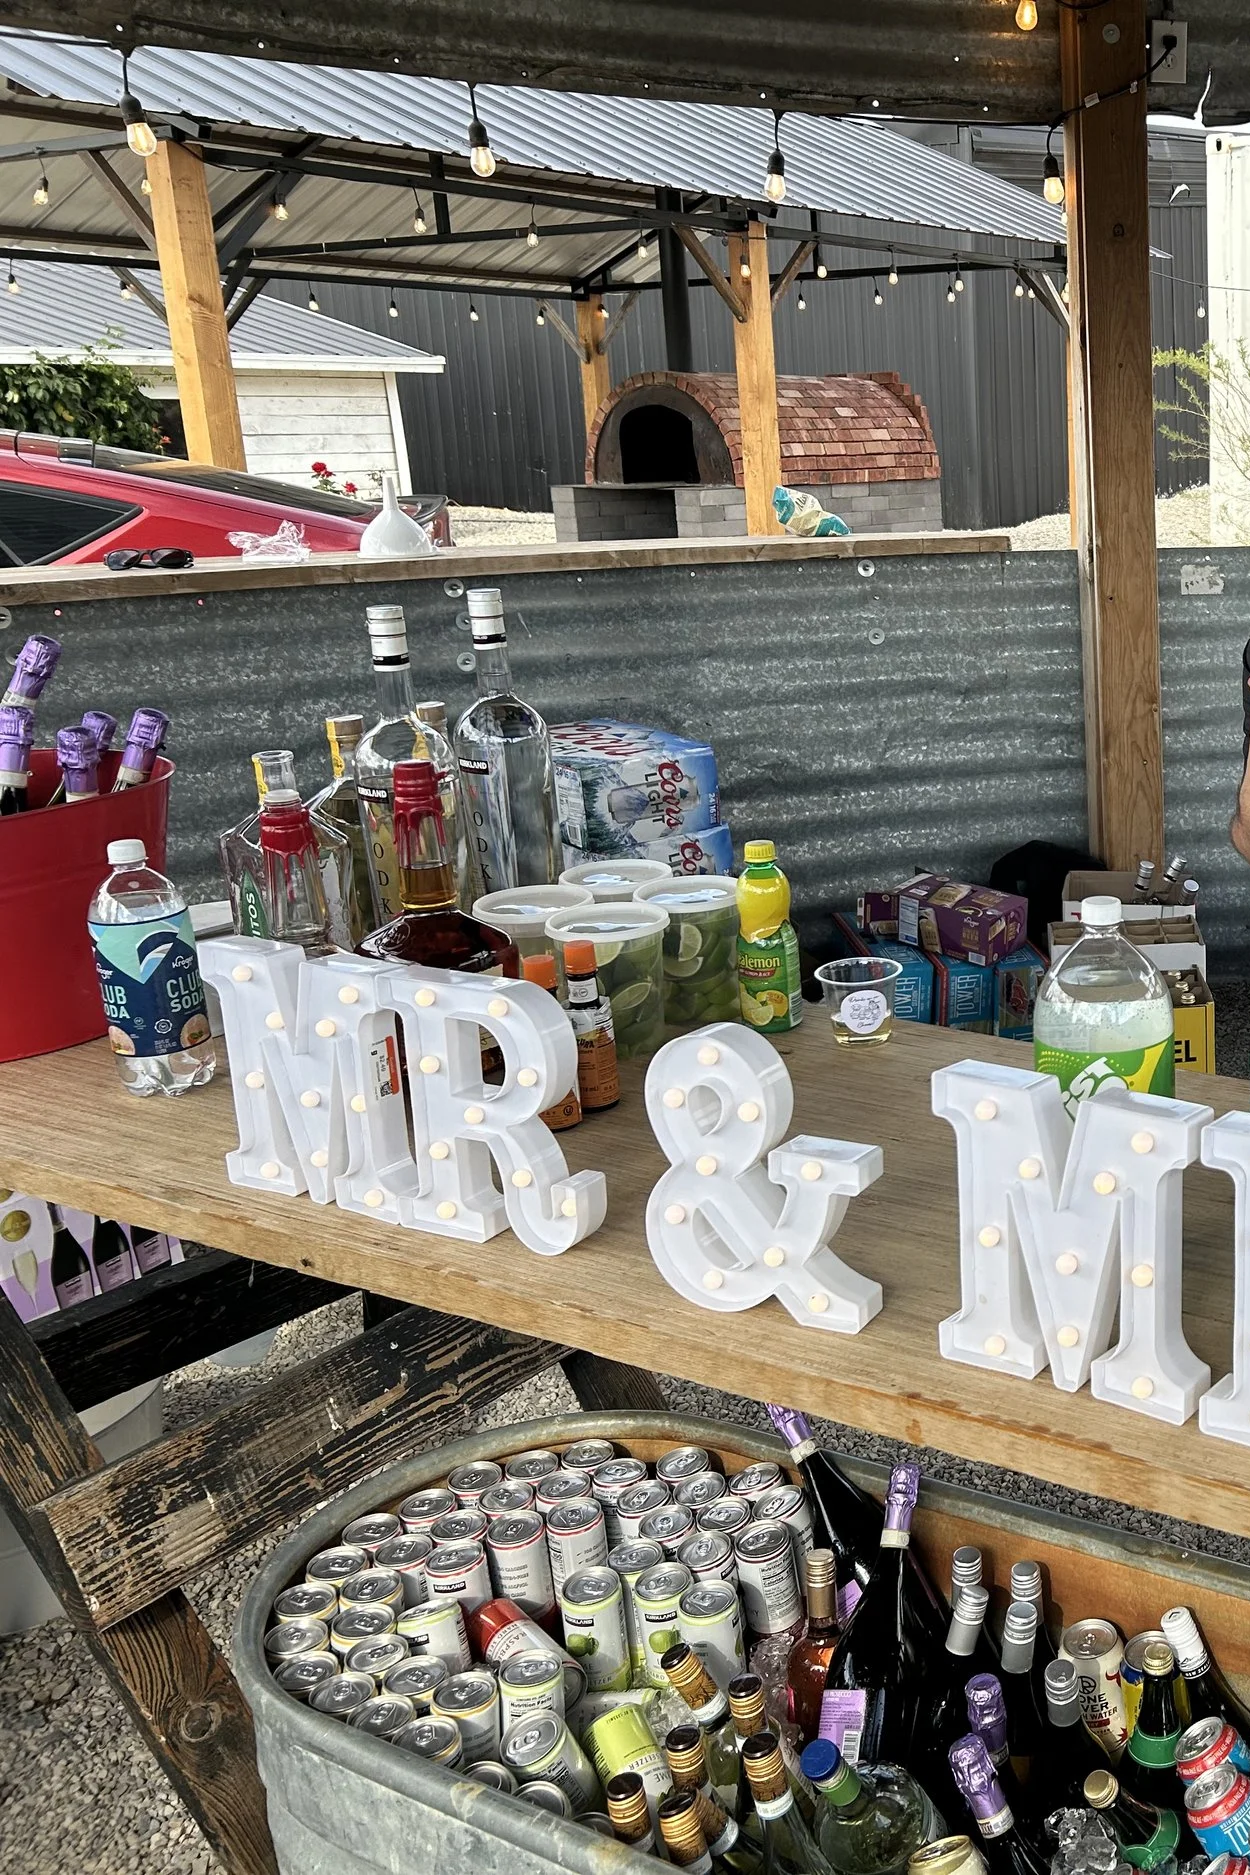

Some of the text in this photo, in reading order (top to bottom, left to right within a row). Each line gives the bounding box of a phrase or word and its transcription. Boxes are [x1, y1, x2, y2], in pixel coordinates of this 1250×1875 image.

[459, 757, 487, 771] KIRKLAND
[357, 785, 388, 799] KIRKLAND
[645, 771, 666, 824] LIGHT
[658, 753, 684, 829] Coors
[246, 893, 260, 937] ITOS
[172, 955, 195, 969] Kroger
[100, 983, 127, 1005] LUB
[956, 974, 980, 1018] TOWER
[643, 1022, 885, 1337] &
[434, 1582, 465, 1592] KIRKLAND
[646, 1612, 677, 1620] KIRKLAND
[510, 1696, 553, 1709] Nutrition Facts
[1090, 1706, 1118, 1720] WATER
[557, 1771, 570, 1783] 100
